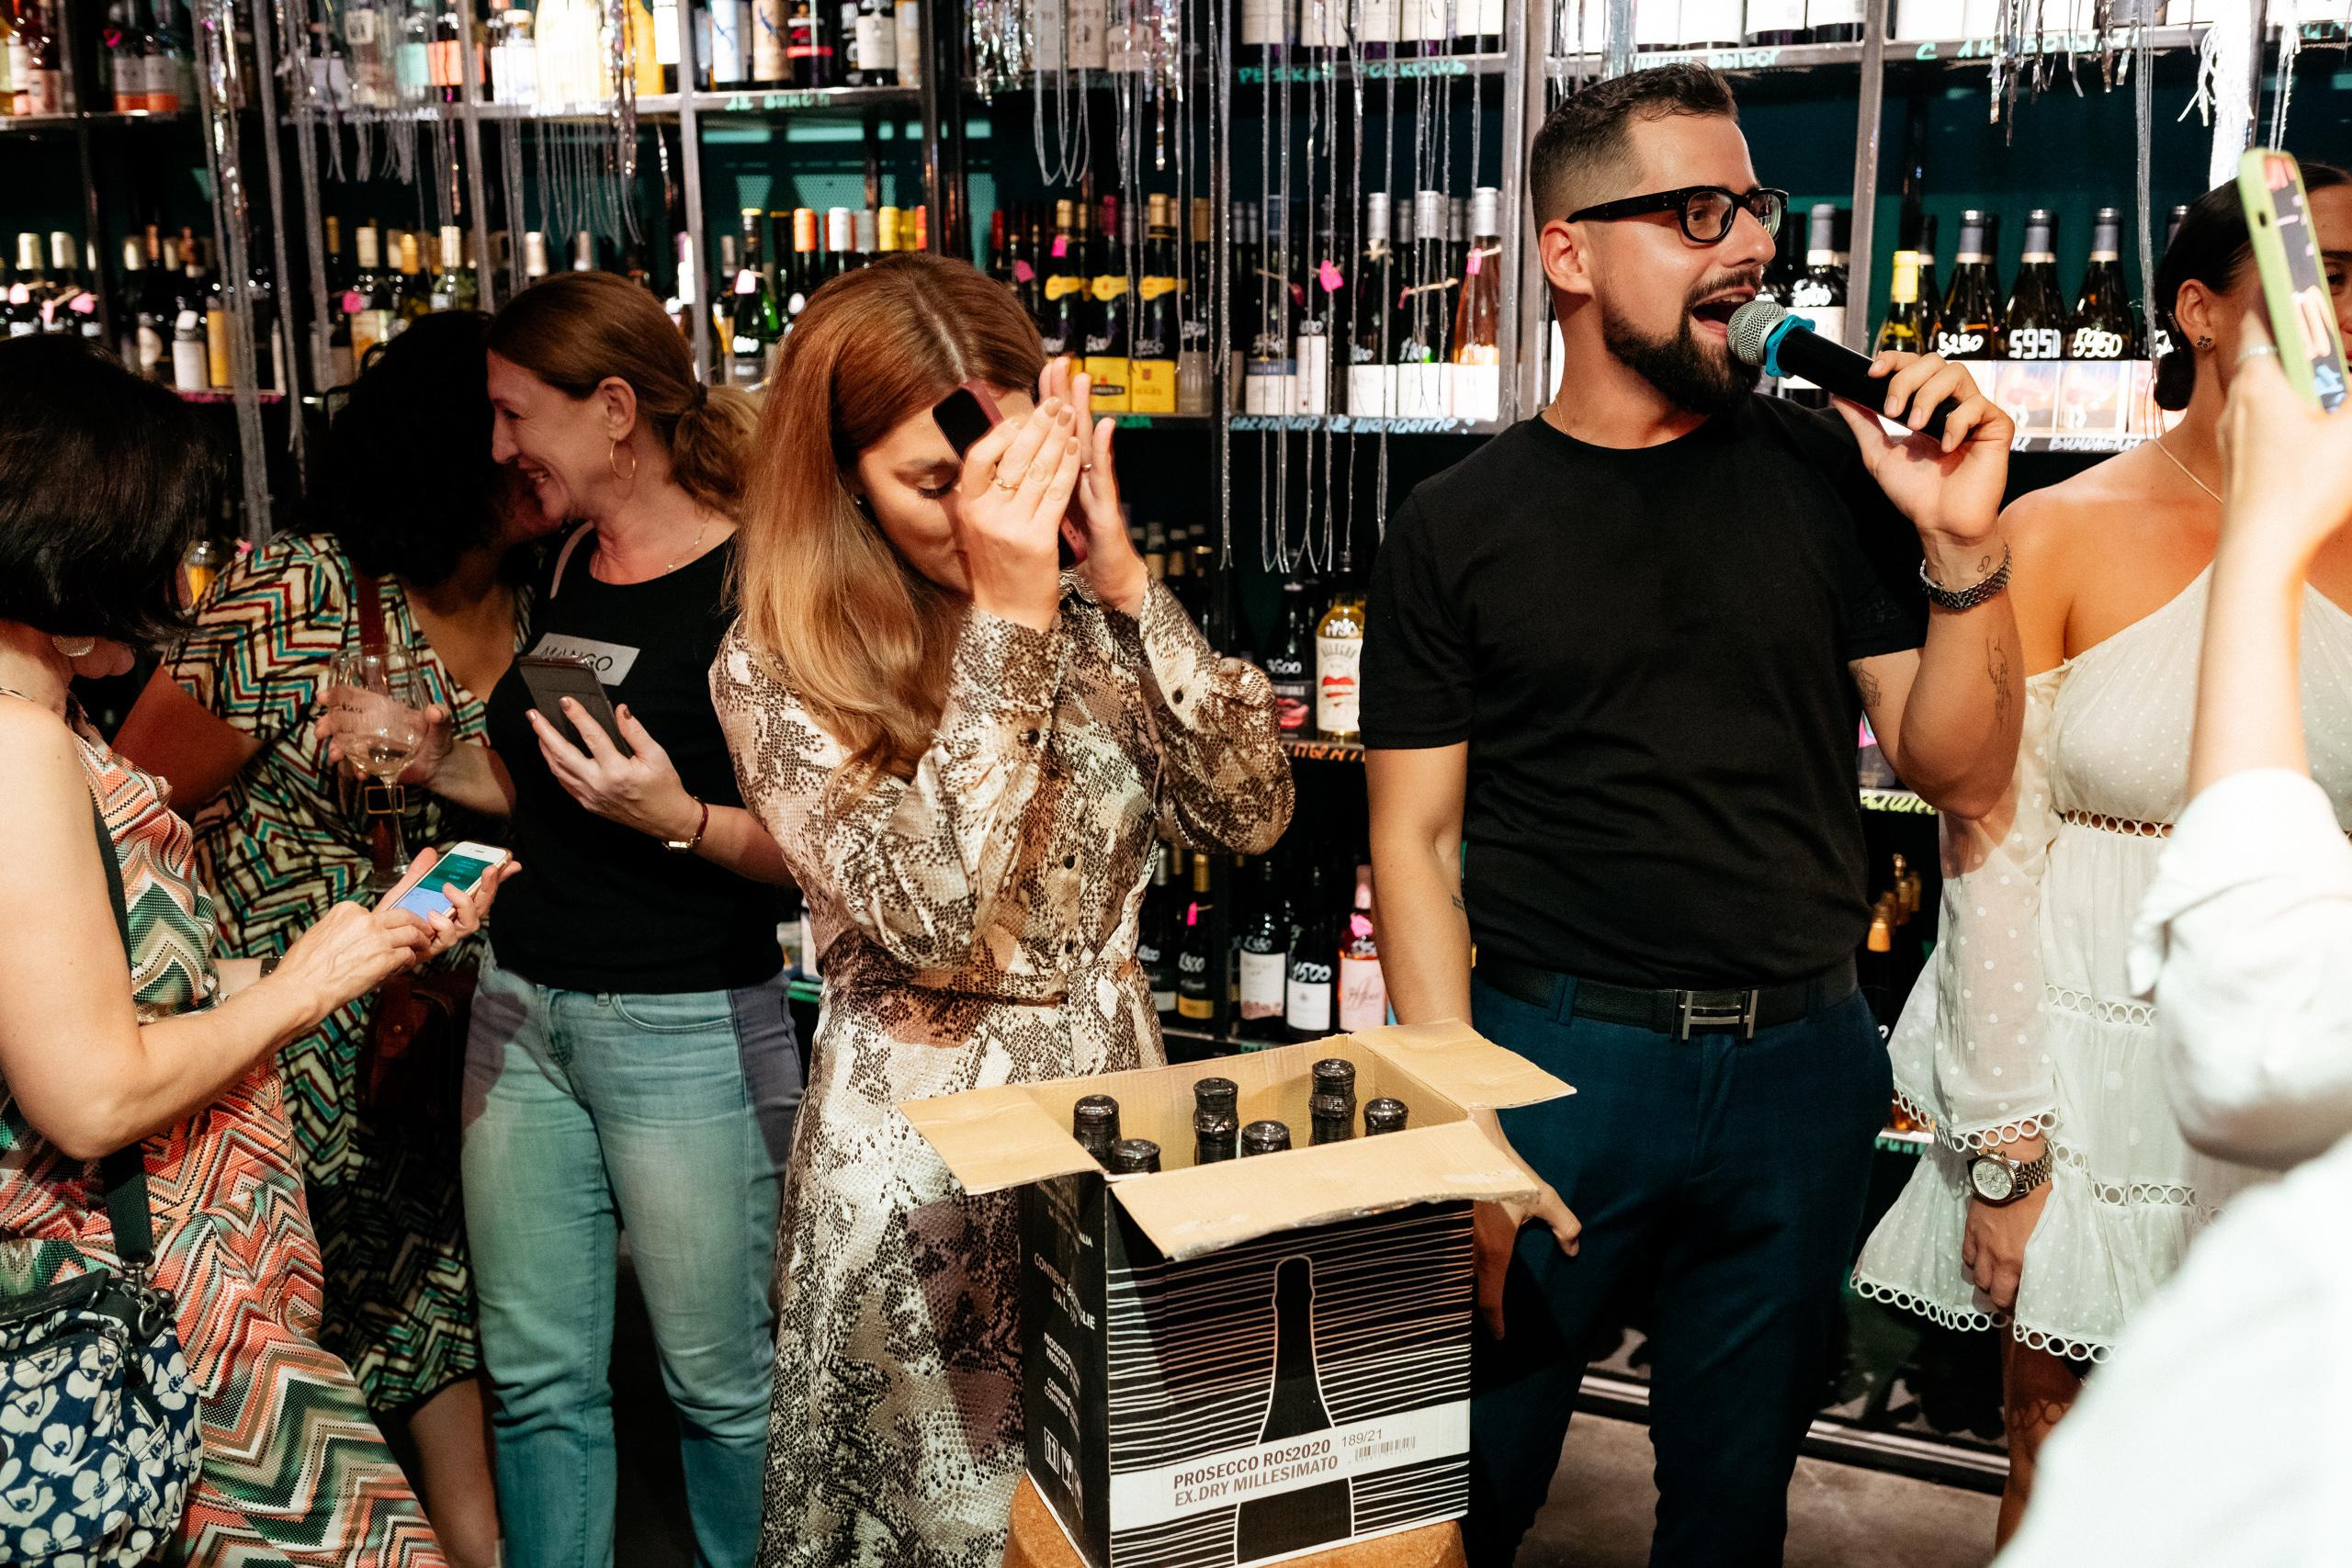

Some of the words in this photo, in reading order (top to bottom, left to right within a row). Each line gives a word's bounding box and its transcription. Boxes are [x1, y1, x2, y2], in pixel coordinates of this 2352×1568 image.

[2073, 327, 2122, 358] 5950
[1292, 961, 1331, 982] 1500
[1034, 1252, 1066, 1292] CONTIENE
[1046, 1347, 1069, 1376] PRODUCT
[1340, 1429, 1383, 1449] 189/21
[1174, 1456, 1259, 1489] PROSECCO
[1174, 1481, 1229, 1506] EX.DRY
[1233, 1455, 1339, 1493] MILLESIMATO
